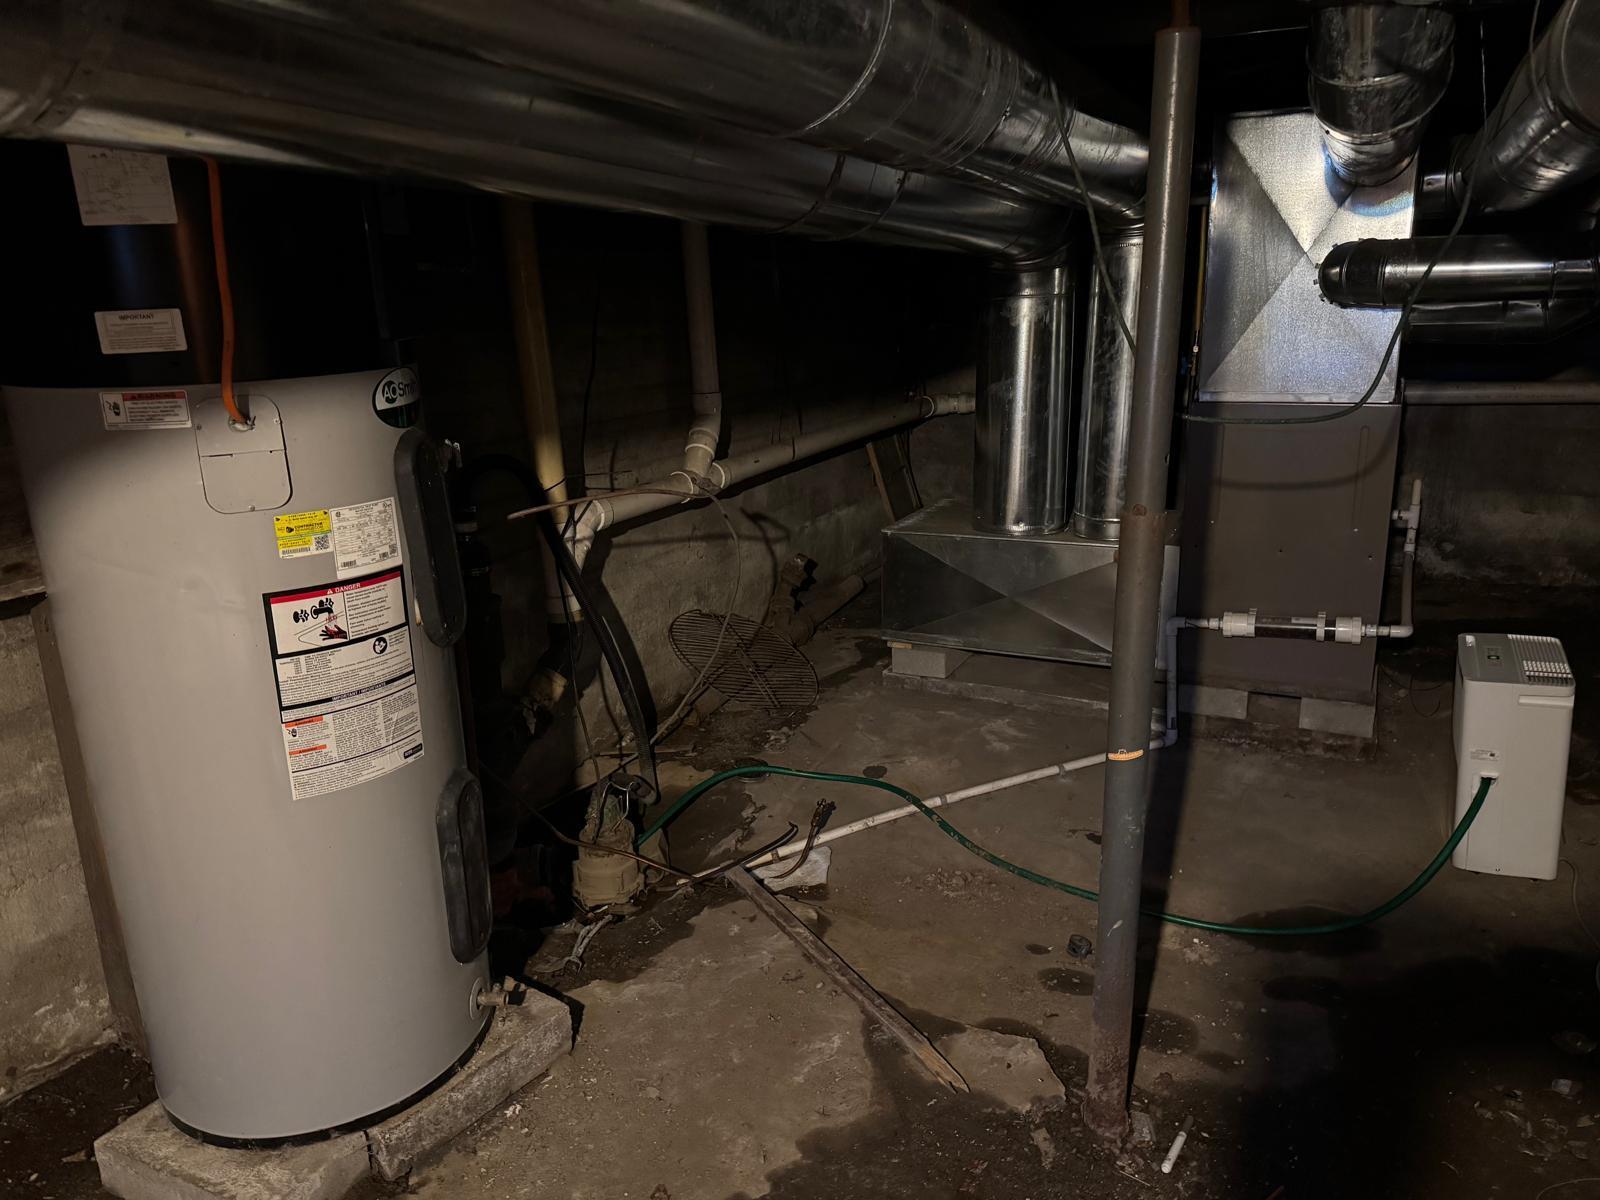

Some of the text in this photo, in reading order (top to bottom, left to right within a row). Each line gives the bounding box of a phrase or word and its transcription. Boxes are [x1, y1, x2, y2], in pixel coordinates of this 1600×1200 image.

[118, 313, 154, 321] IMPORTANT
[335, 582, 361, 593] DANGER
[332, 691, 357, 701] IMPORTANT
